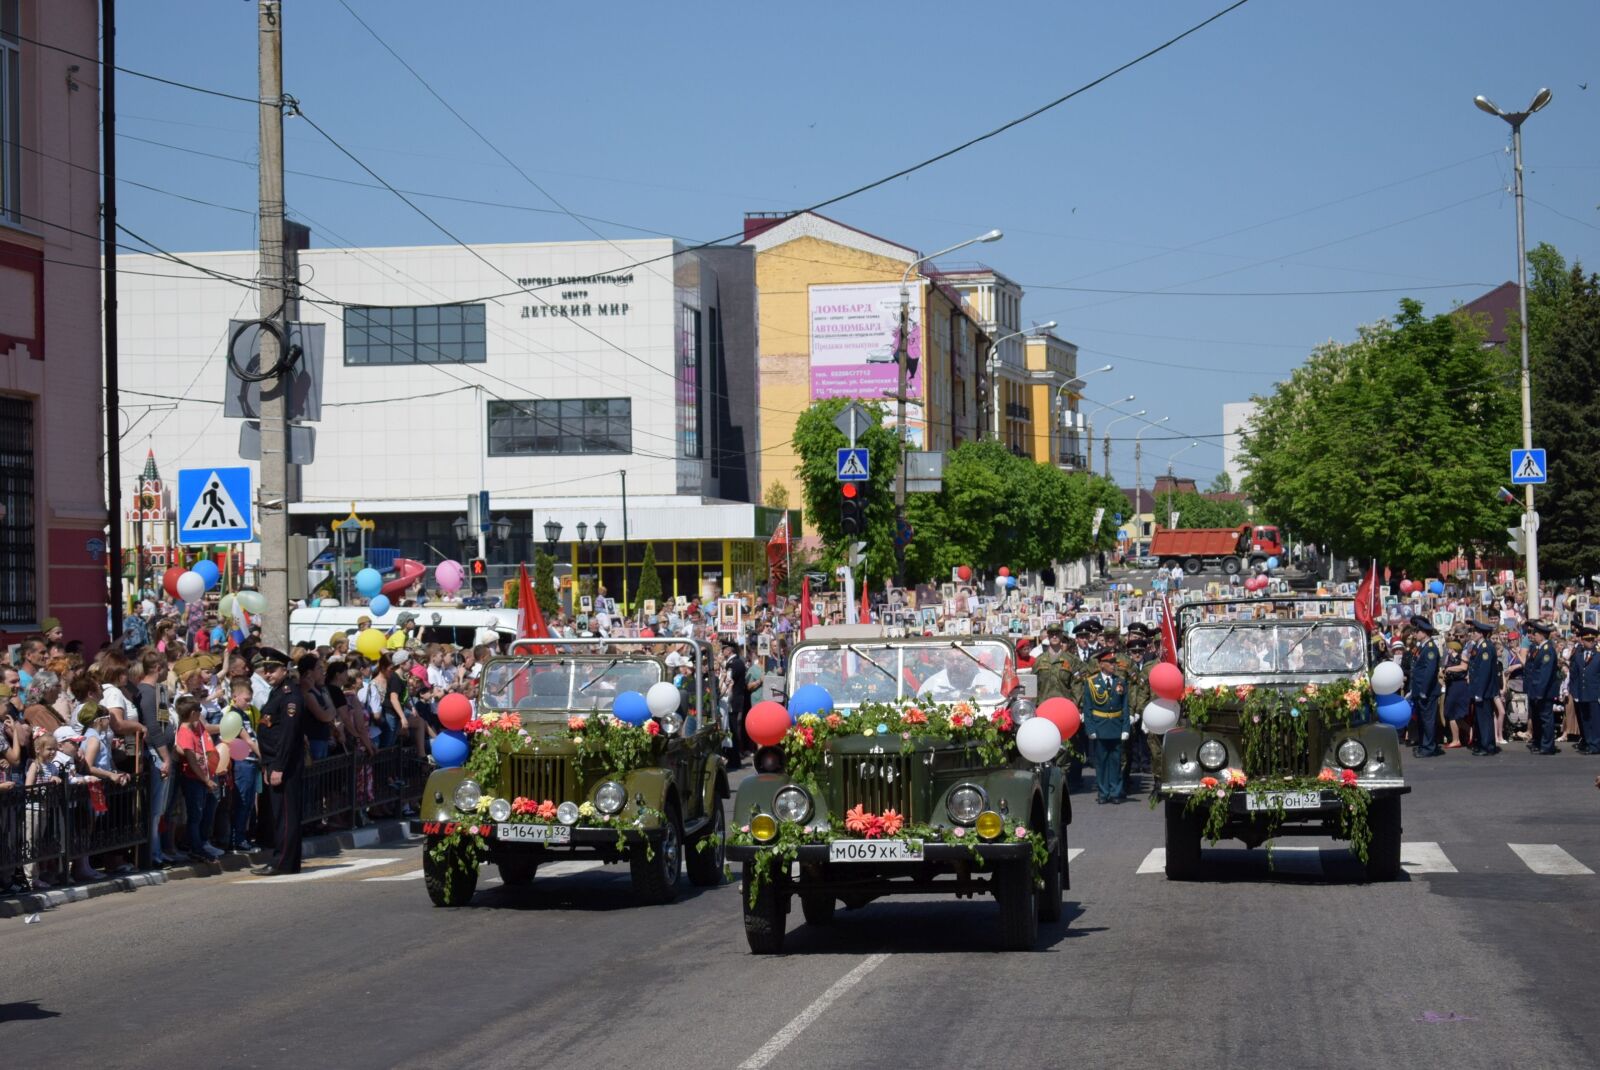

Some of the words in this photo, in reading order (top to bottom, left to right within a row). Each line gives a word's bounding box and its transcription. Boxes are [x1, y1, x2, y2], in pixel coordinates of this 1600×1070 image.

[562, 291, 588, 300] ЦЕНТР
[521, 303, 591, 318] ДЕТСКИЙ
[598, 303, 629, 316] МИР
[814, 303, 872, 314] ЛОМБАРД
[815, 322, 882, 333] АВТОЛОМБАРД
[1305, 793, 1316, 802] 32
[554, 826, 567, 836] 32
[836, 844, 897, 859] М069ХК
